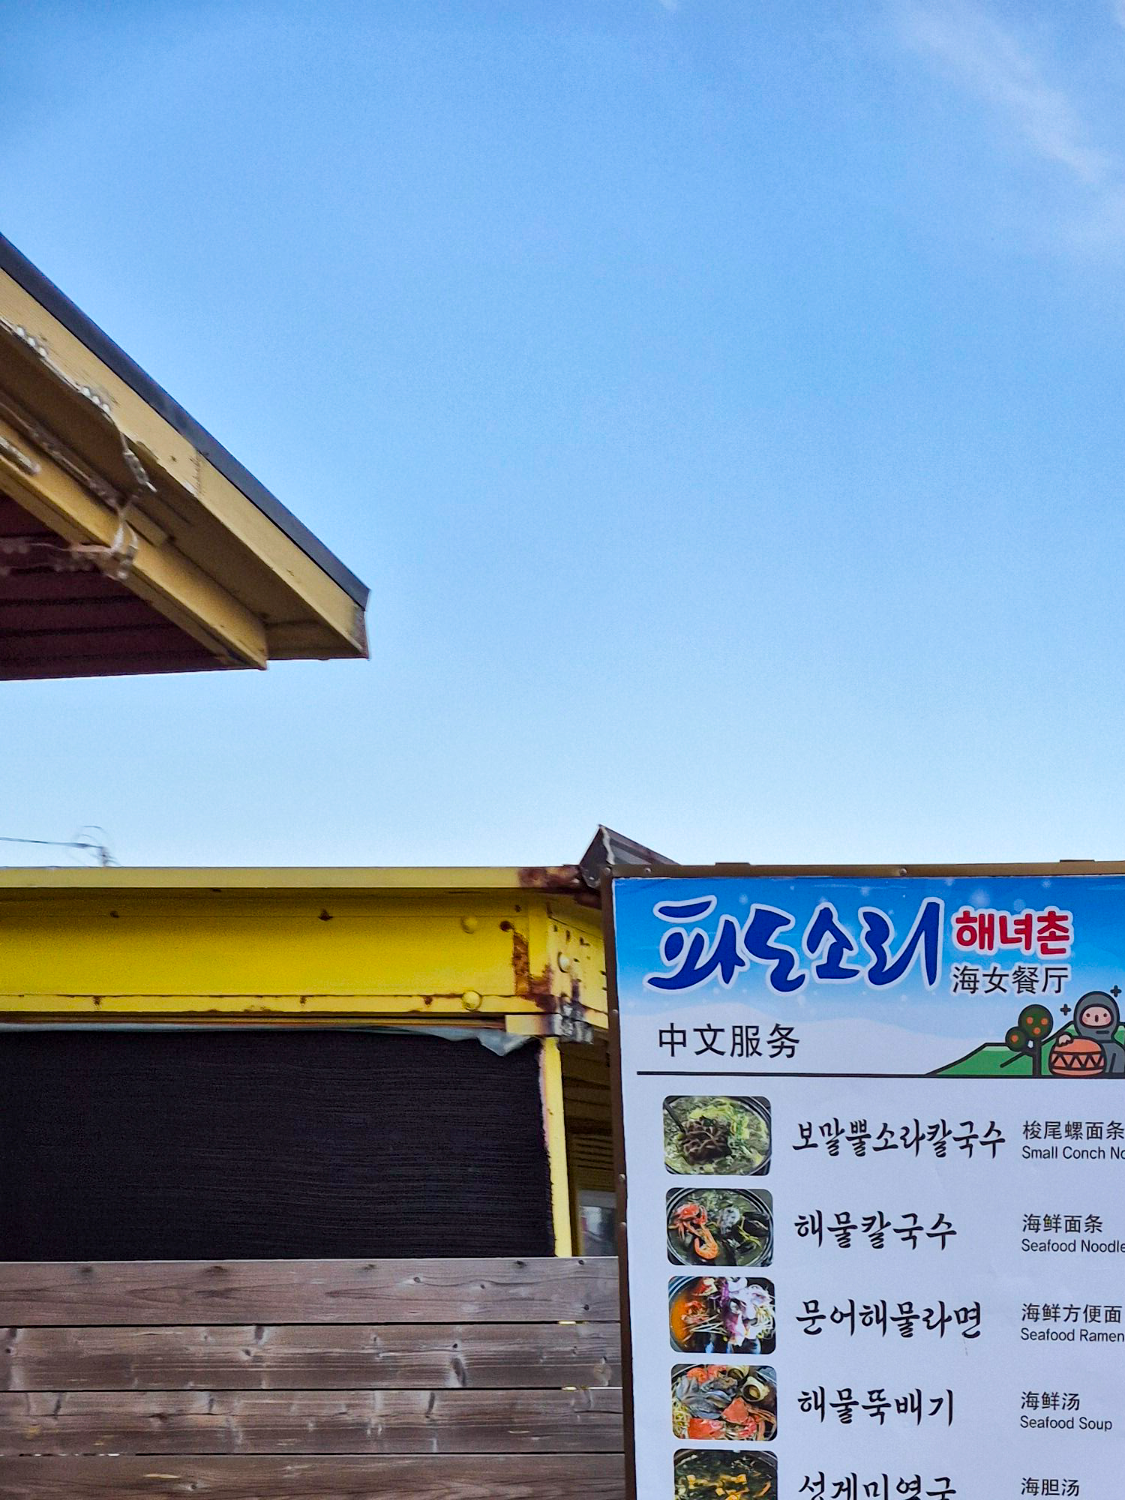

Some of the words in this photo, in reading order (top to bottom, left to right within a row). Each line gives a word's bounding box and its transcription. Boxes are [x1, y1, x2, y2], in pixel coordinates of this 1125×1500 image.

[645, 895, 944, 993] 파도소리
[956, 910, 1073, 955] 해녀촌
[952, 966, 1070, 995] 海女餐厅
[659, 1023, 800, 1058] 中文服务
[793, 1118, 1005, 1158] 보말뿔소라칼국수
[1023, 1121, 1124, 1140] 梭尾螺面条
[1022, 1146, 1057, 1159] Small
[1063, 1146, 1105, 1159] Conch
[794, 1210, 957, 1250] 해물칼국수
[1023, 1214, 1102, 1233] 海鲜面条
[1022, 1239, 1076, 1252] Seafood
[796, 1299, 980, 1338] 문어해물라면
[1022, 1303, 1122, 1323] 海鲜方便面
[1021, 1328, 1075, 1341] Seafood
[1080, 1329, 1124, 1342] Ramen
[798, 1386, 953, 1426] 해물뚝배기
[1021, 1391, 1079, 1410] 海鲜汤
[1020, 1415, 1074, 1429] Seafood
[1079, 1417, 1112, 1431] Soup
[1021, 1477, 1079, 1496] 海胆汤
